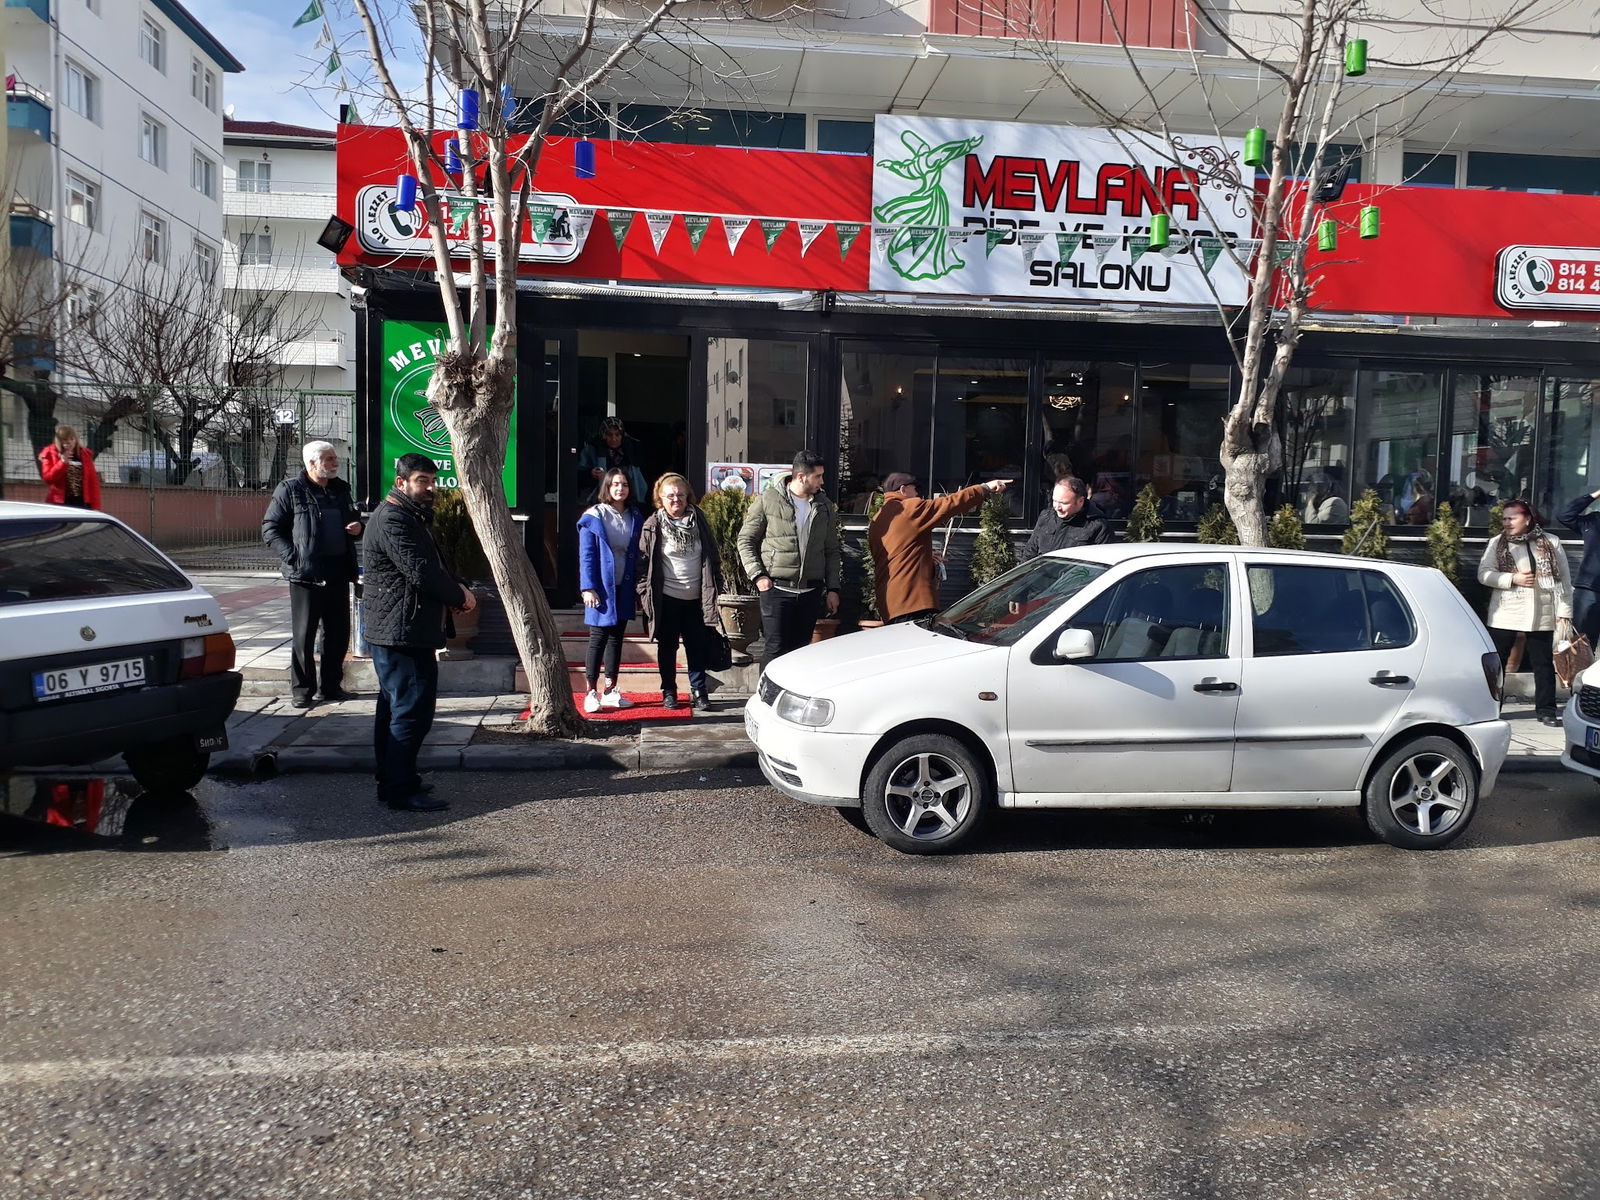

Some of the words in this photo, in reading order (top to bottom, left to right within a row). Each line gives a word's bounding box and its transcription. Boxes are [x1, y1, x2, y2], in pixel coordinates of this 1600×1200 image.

[963, 153, 1200, 221] MEVLANA
[368, 190, 388, 223] LEZZET
[529, 205, 554, 214] MEVLANA
[569, 208, 594, 216] MEVLANA
[607, 211, 632, 219] MEVLANA
[685, 216, 710, 224] MEVLANA
[724, 219, 748, 227] MEVLANA
[762, 221, 785, 229] MEVLANA
[800, 223, 824, 231] MEVLANA
[836, 225, 860, 233] MEVLANA
[372, 227, 390, 245] ALO
[1509, 250, 1528, 280] LEZZET
[1559, 263, 1587, 276] 814
[1030, 261, 1171, 292] SALONU
[1557, 278, 1585, 291] 814
[1511, 284, 1526, 300] ALO
[277, 410, 293, 422] 12
[46, 673, 69, 692] 06
[79, 668, 88, 686] Y
[100, 661, 142, 683] 9715
